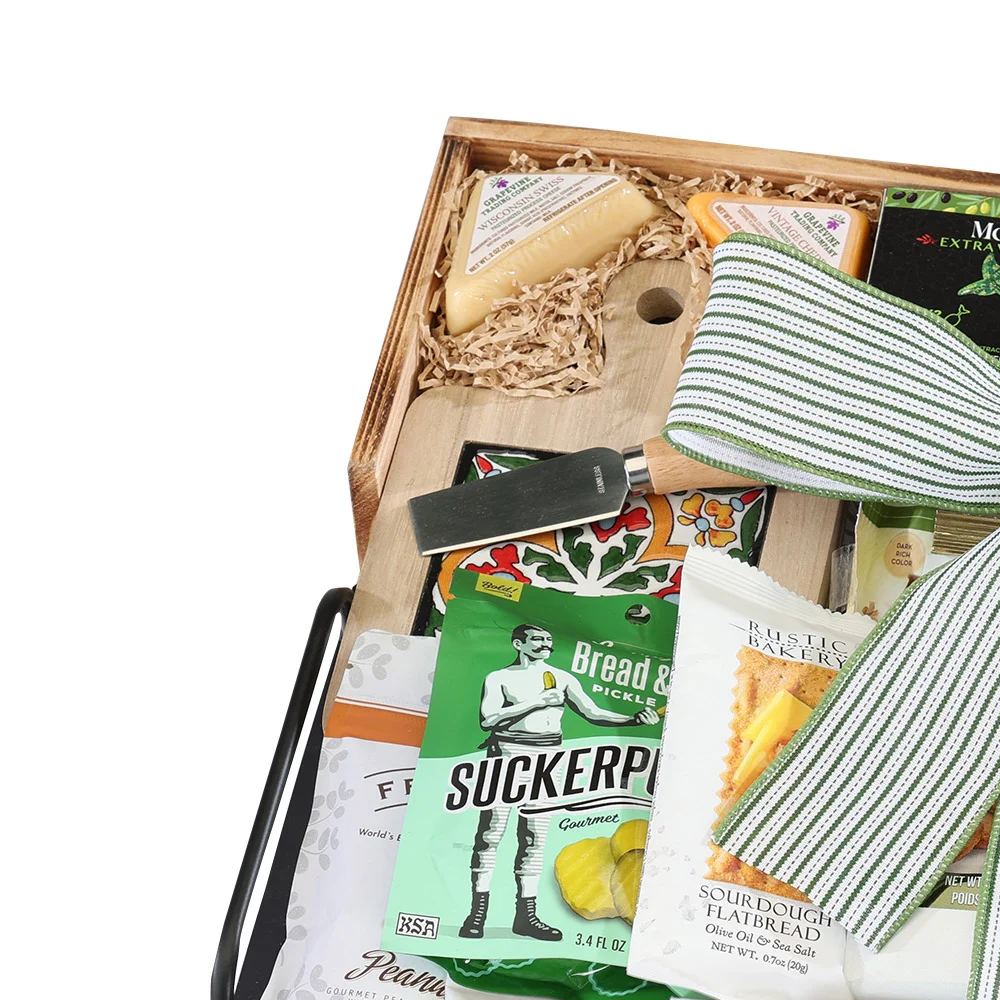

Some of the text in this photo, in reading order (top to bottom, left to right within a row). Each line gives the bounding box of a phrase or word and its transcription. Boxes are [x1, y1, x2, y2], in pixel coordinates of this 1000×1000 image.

[478, 193, 534, 232] WISCONSIN
[536, 176, 564, 196] SWISS
[484, 176, 531, 206] GRAPEVINE
[767, 207, 800, 242] VINTAGE
[790, 210, 837, 258] TRADING COMPANY
[803, 211, 841, 248] GRAPEVINE
[940, 237, 994, 252] EXTRA
[891, 558, 912, 567] COLOR
[481, 581, 520, 597] Bold!
[748, 634, 848, 668] BAKERY
[749, 620, 847, 653] RUSTIC
[571, 641, 671, 695] Bread &
[592, 684, 656, 707] PICKLE
[358, 828, 393, 841] World's
[558, 814, 620, 831] Gourmet
[945, 875, 982, 888] NET WT
[699, 884, 832, 927] SOURDOUGH
[951, 892, 979, 905] POIDS
[707, 904, 821, 942] FLATBREAD
[575, 933, 626, 952] 3.4 FL OZ
[705, 923, 816, 958] Olive Oil & Sea Salt
[711, 941, 809, 974] NET WT. 0.7oz (20g)
[326, 986, 376, 1000] GOURMET
